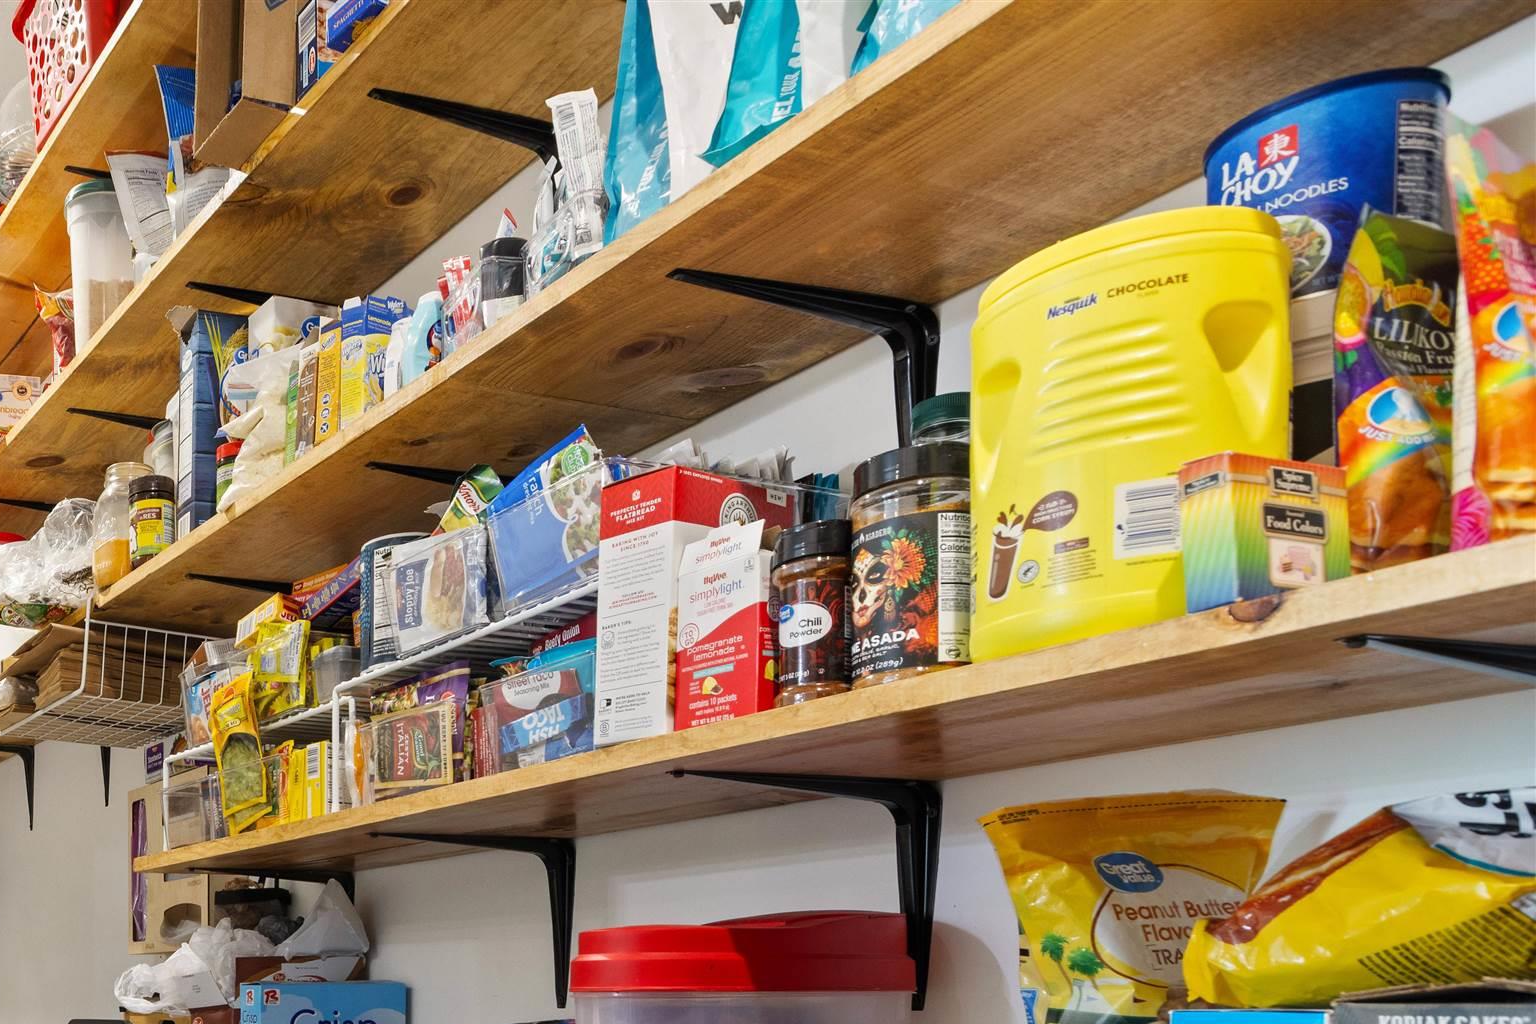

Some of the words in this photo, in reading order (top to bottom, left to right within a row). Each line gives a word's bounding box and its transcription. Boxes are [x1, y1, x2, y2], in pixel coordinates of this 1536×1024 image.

[1260, 133, 1297, 167] 東
[1221, 151, 1256, 191] LA
[1221, 156, 1300, 208] CHOY
[1265, 176, 1350, 214] NOODLES
[1107, 273, 1189, 299] CHOCOLATE
[1047, 293, 1098, 320] Nesquik
[1376, 341, 1423, 363] Passion
[1358, 427, 1394, 442] JUST
[1282, 470, 1305, 483] Spice
[458, 481, 481, 514] Knorr
[528, 477, 544, 516] ranch
[610, 504, 639, 518] PERFECTLY
[640, 497, 662, 508] TENDER
[616, 505, 656, 522] FLATBREAD
[1266, 515, 1291, 530] Food
[1293, 518, 1324, 535] Colors
[695, 541, 742, 564] simplylight
[405, 592, 416, 626] Sloppy
[798, 616, 823, 629] Chili
[544, 632, 562, 650] Beefy
[562, 624, 581, 642] Onion
[684, 630, 693, 638] TO
[684, 637, 695, 646] GO
[789, 627, 823, 640] Powder
[862, 628, 920, 650] ASADA
[687, 635, 743, 656] pomegranate
[693, 645, 735, 662] lemonade
[513, 684, 541, 697] Seasoning
[541, 682, 550, 691] Mix
[689, 699, 710, 710] contains
[710, 697, 717, 706] 10
[717, 693, 737, 704] packets
[522, 705, 564, 730] TACO
[529, 724, 560, 744] FISH
[396, 723, 404, 776] ITALIAN
[1100, 861, 1149, 876] Great
[1112, 902, 1180, 922] Peanut
[1186, 899, 1242, 920] Butter
[242, 1010, 258, 1024] Crisp
